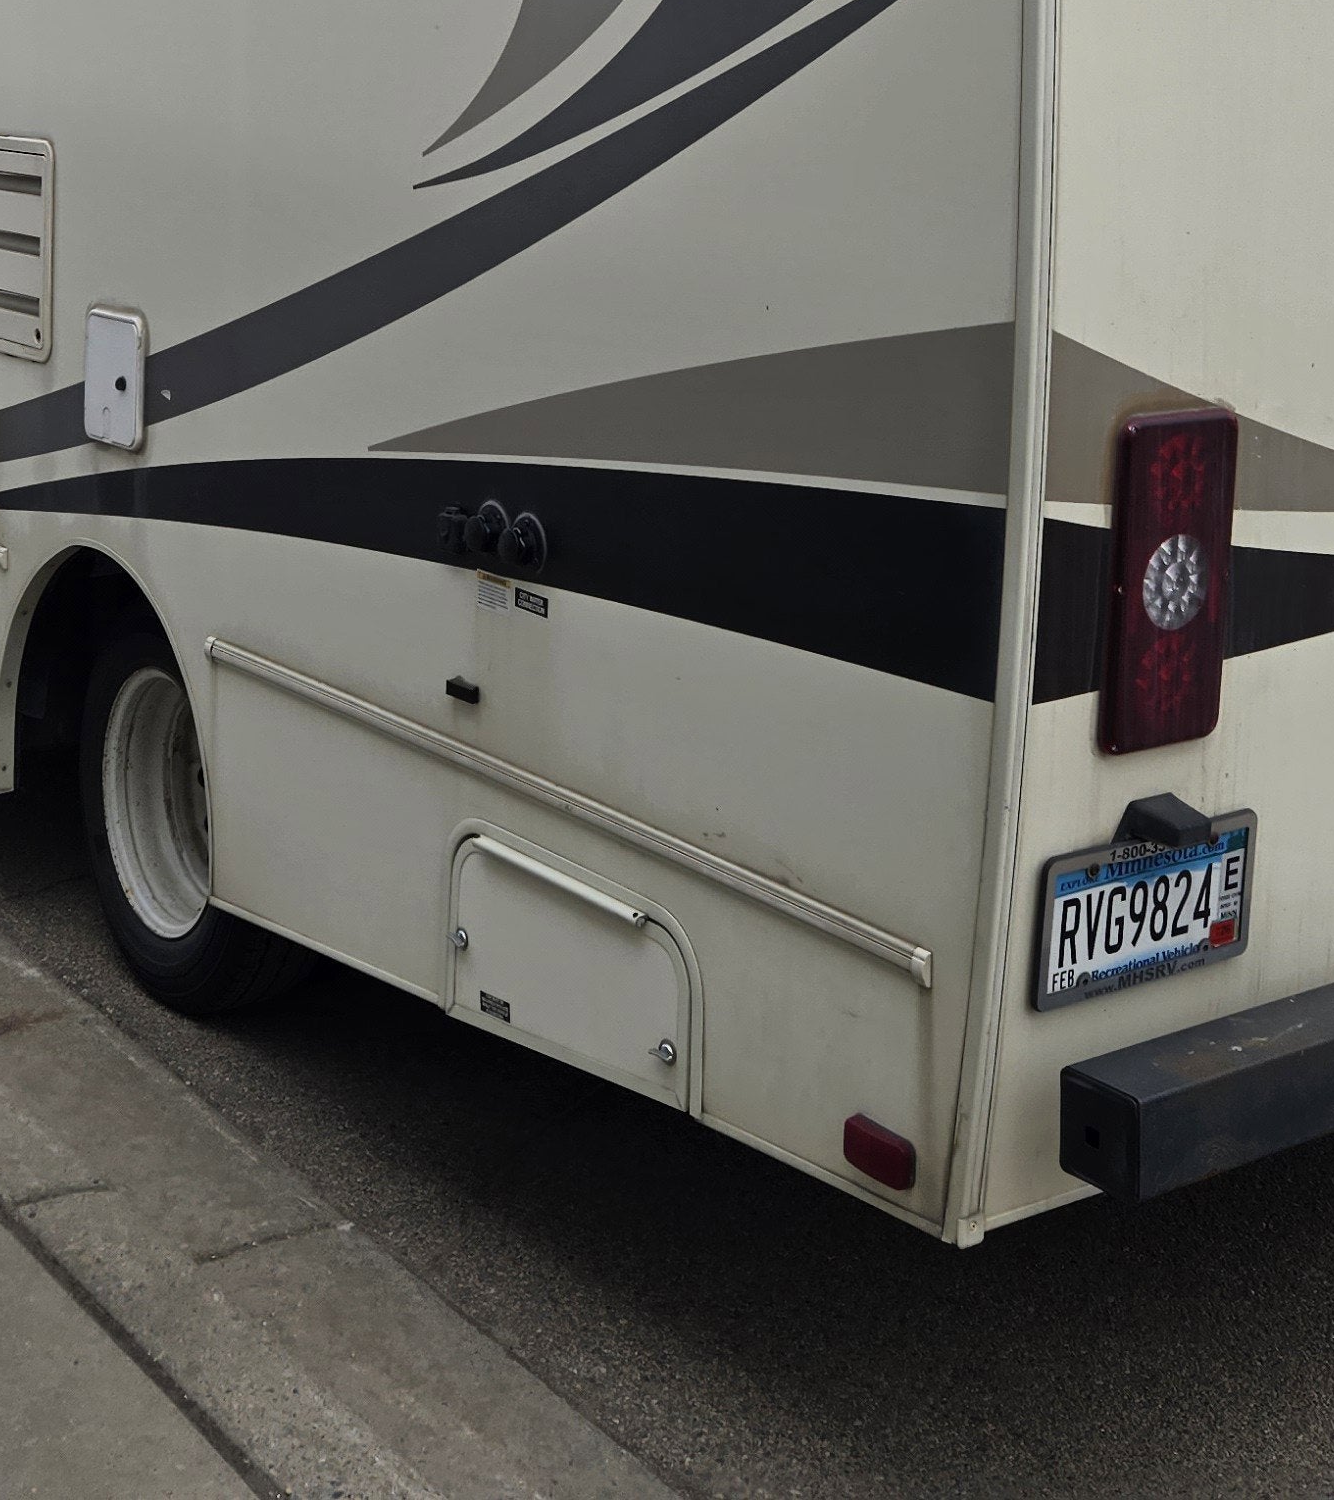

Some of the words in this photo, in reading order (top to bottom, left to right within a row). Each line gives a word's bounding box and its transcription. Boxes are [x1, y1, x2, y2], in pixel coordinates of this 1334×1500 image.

[1224, 855, 1240, 891] E
[1058, 862, 1214, 969] RVG9824
[1052, 969, 1075, 992] FEB
[1084, 957, 1206, 1000] www.MHSRV.com
[1091, 952, 1159, 982] Recreational
